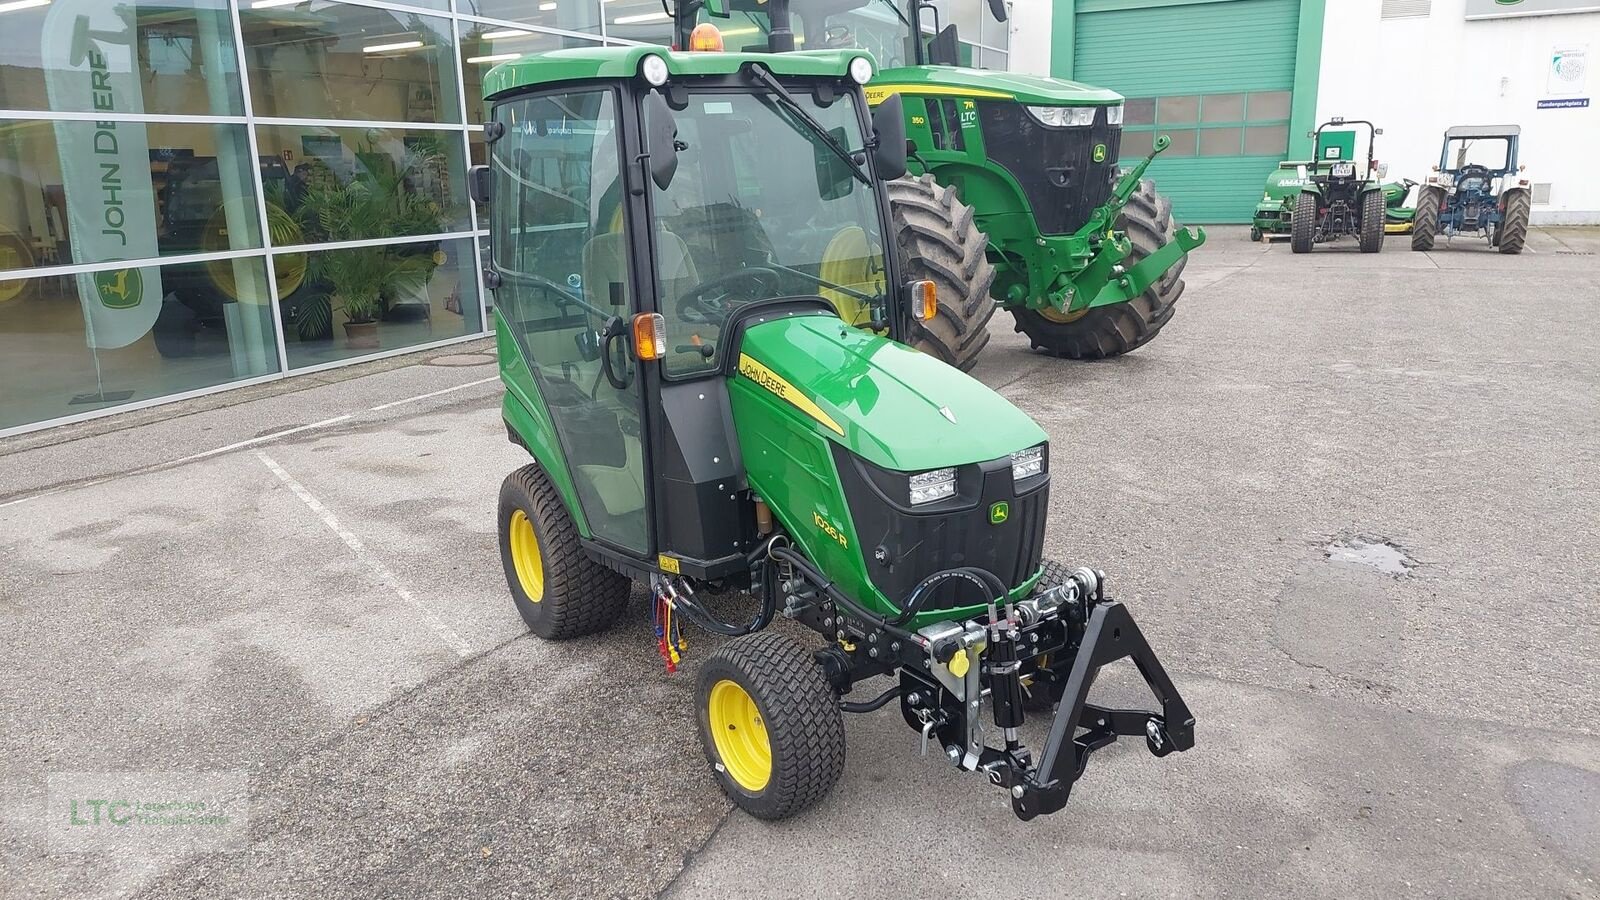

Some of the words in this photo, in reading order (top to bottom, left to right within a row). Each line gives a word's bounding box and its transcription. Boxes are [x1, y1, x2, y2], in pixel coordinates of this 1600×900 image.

[865, 91, 884, 99] DEERE
[961, 111, 976, 122] LTC
[102, 163, 127, 246] JOHN
[743, 361, 760, 380] JOHN
[760, 371, 787, 396] DEERE
